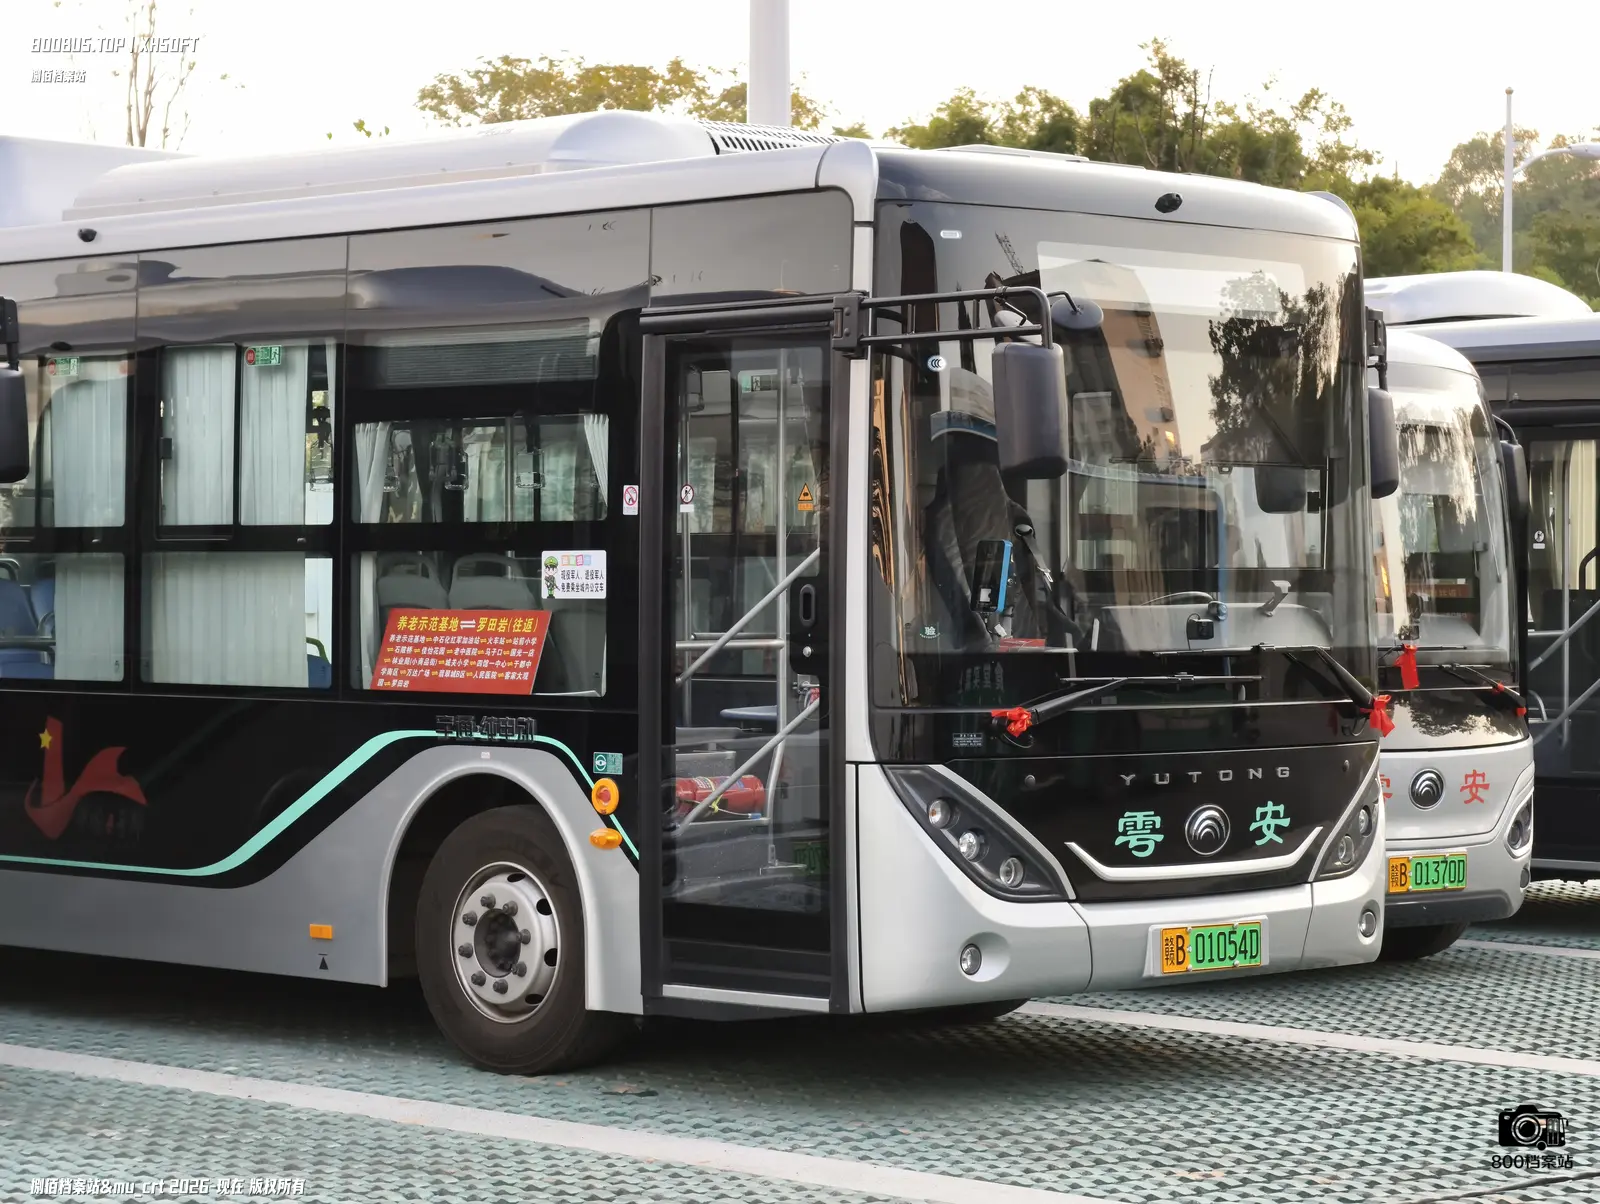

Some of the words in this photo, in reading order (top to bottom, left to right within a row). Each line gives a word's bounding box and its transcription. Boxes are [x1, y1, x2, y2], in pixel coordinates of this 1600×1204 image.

[397, 616, 460, 632] 养老示范基地
[477, 617, 538, 633] 罗田岩(往返)
[1120, 766, 1290, 786] YUTONG
[1460, 769, 1490, 804] 安
[1249, 800, 1291, 846] 安
[1415, 859, 1466, 886] 01370D
[1195, 929, 1260, 964] 01054D
